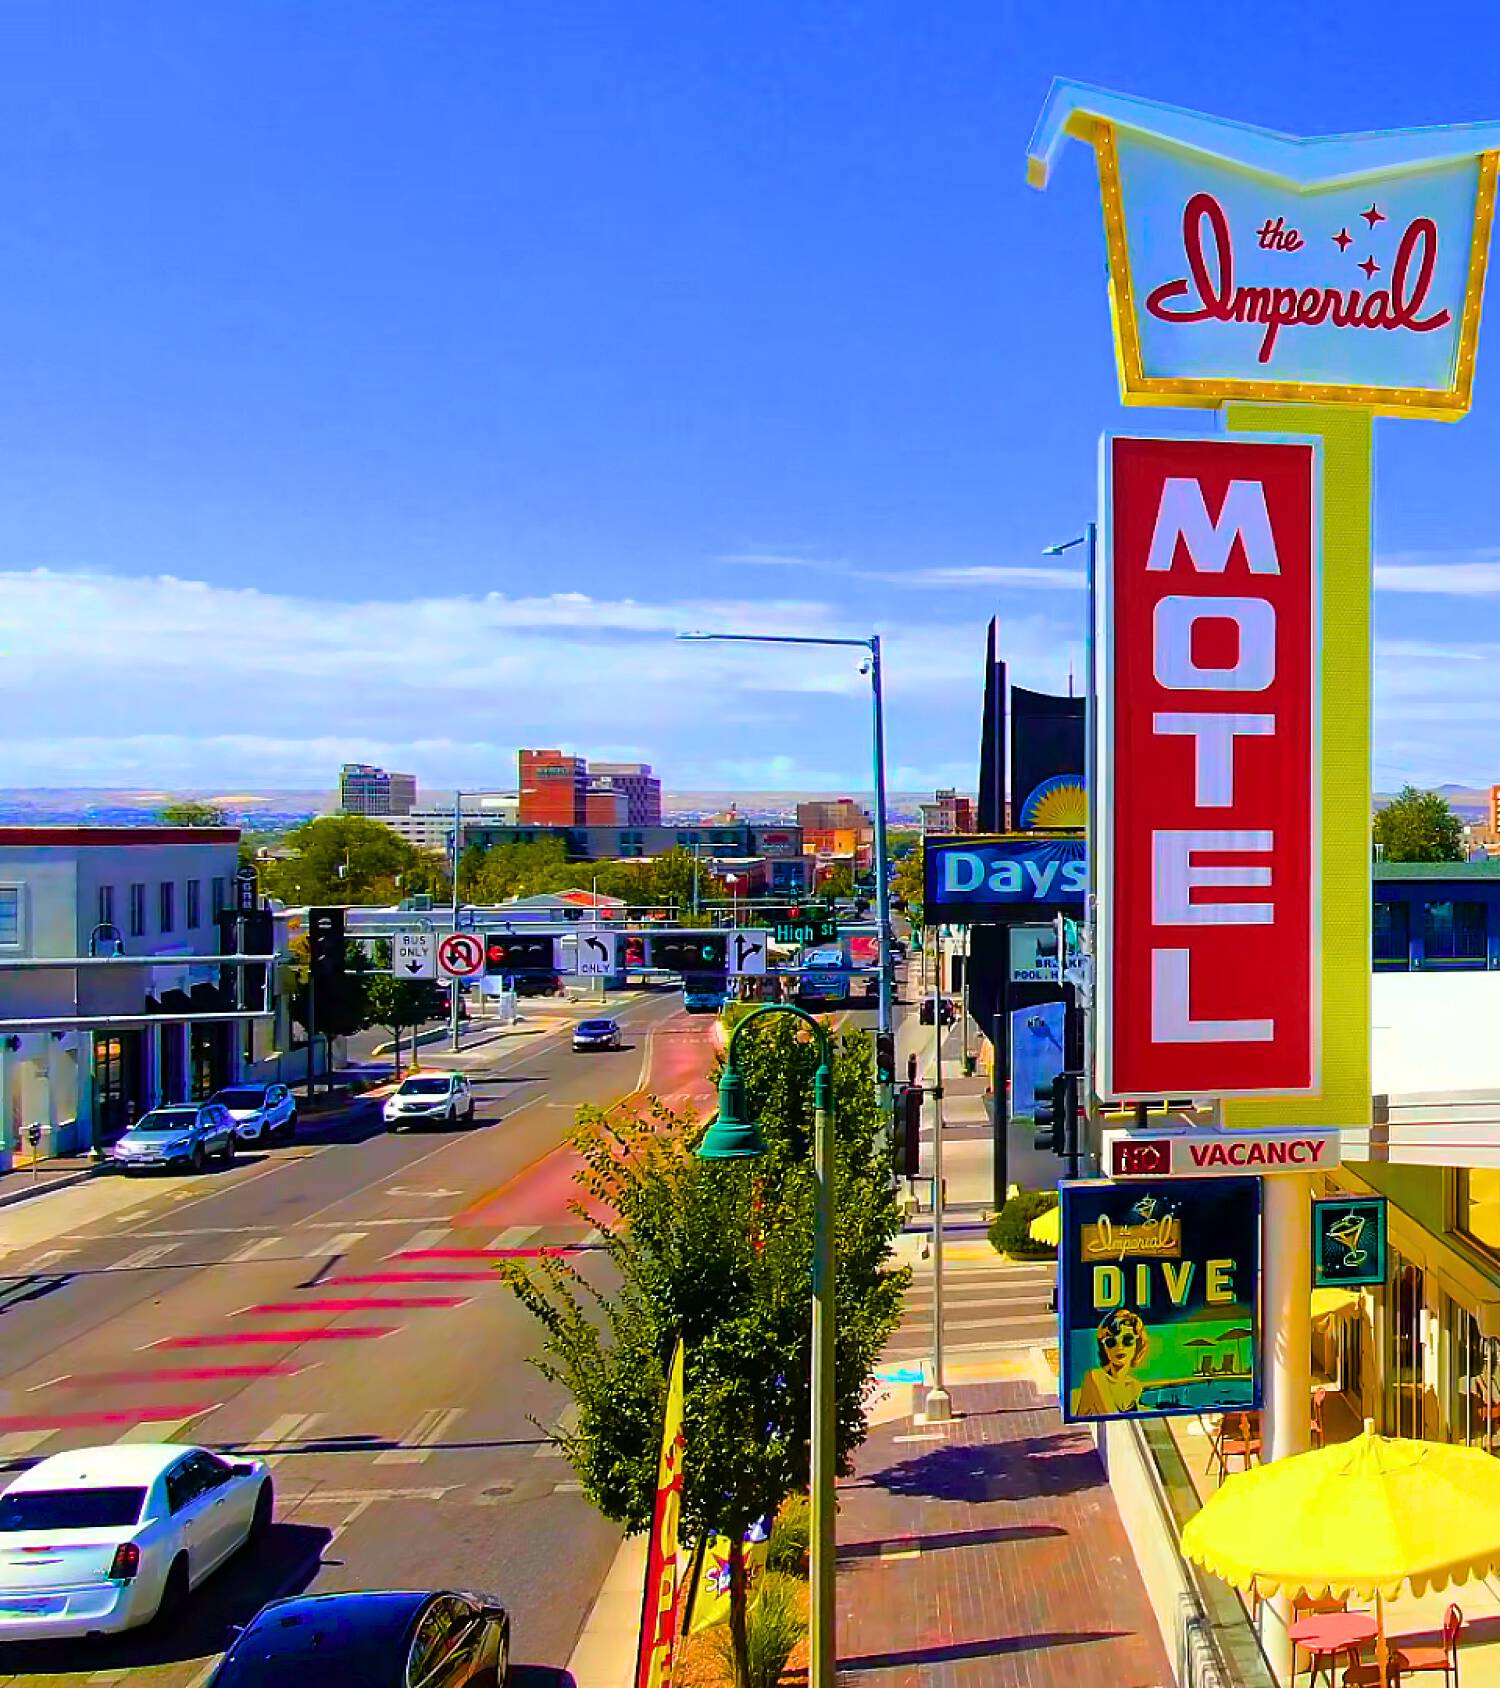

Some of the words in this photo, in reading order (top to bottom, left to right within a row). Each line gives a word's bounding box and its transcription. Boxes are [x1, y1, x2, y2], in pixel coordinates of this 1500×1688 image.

[1256, 217, 1304, 251] the
[1146, 193, 1451, 363] Imperial
[1146, 477, 1282, 1043] MOTEL
[944, 851, 1088, 899] Days
[402, 935, 426, 945] BUS
[777, 924, 813, 944] High
[821, 923, 834, 936] St
[400, 947, 428, 957] ONLY
[582, 963, 610, 973] ONLY
[1190, 1140, 1325, 1167] VACANCY
[1087, 1213, 1176, 1262] Imperial
[1093, 1258, 1237, 1309] DIVE
